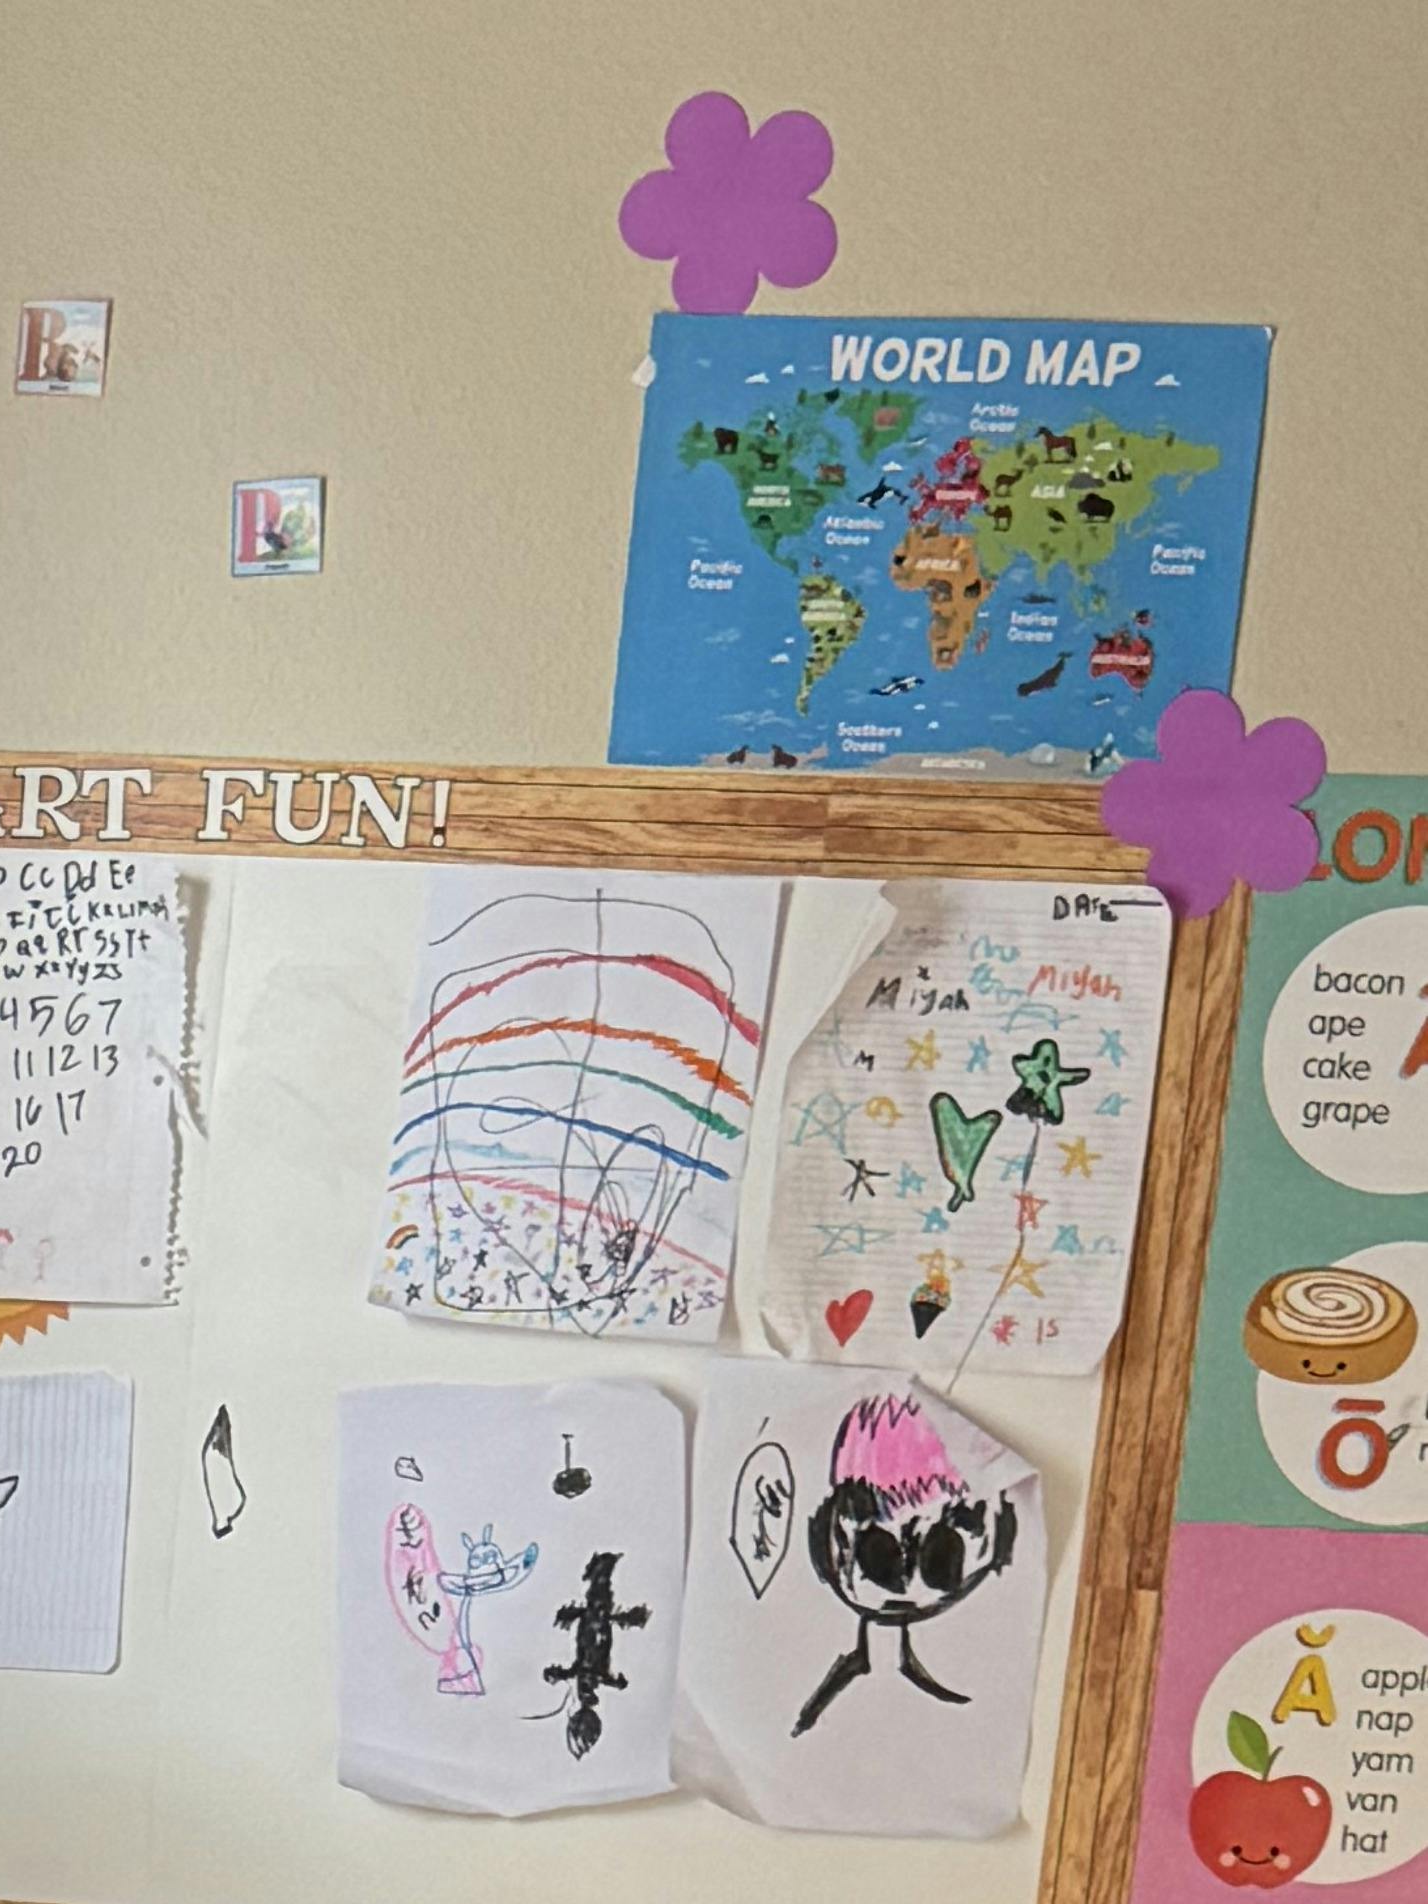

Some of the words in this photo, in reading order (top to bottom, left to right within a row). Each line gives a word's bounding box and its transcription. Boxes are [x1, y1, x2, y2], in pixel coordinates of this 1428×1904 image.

[829, 334, 1012, 385] WORLD
[1024, 338, 1142, 388] MAP
[196, 767, 452, 849] FUN!
[1313, 963, 1406, 996] bacon
[0, 997, 18, 1031] 4
[29, 995, 59, 1038] 5
[64, 992, 91, 1037] 6
[97, 998, 123, 1036] 7
[1308, 1014, 1366, 1044] ape
[14, 1047, 34, 1081] 11
[48, 1044, 83, 1077] 12
[93, 1044, 119, 1078] 13
[1302, 1051, 1372, 1081] cake
[15, 1095, 43, 1132] 16
[56, 1089, 87, 1136] 17
[1301, 1100, 1391, 1131] grape
[1, 1141, 42, 1179] 20
[1361, 1665, 1428, 1698] appl
[1355, 1709, 1415, 1738] nap
[1351, 1751, 1415, 1778] yam
[1345, 1791, 1398, 1814] van
[1341, 1825, 1388, 1854] hat
